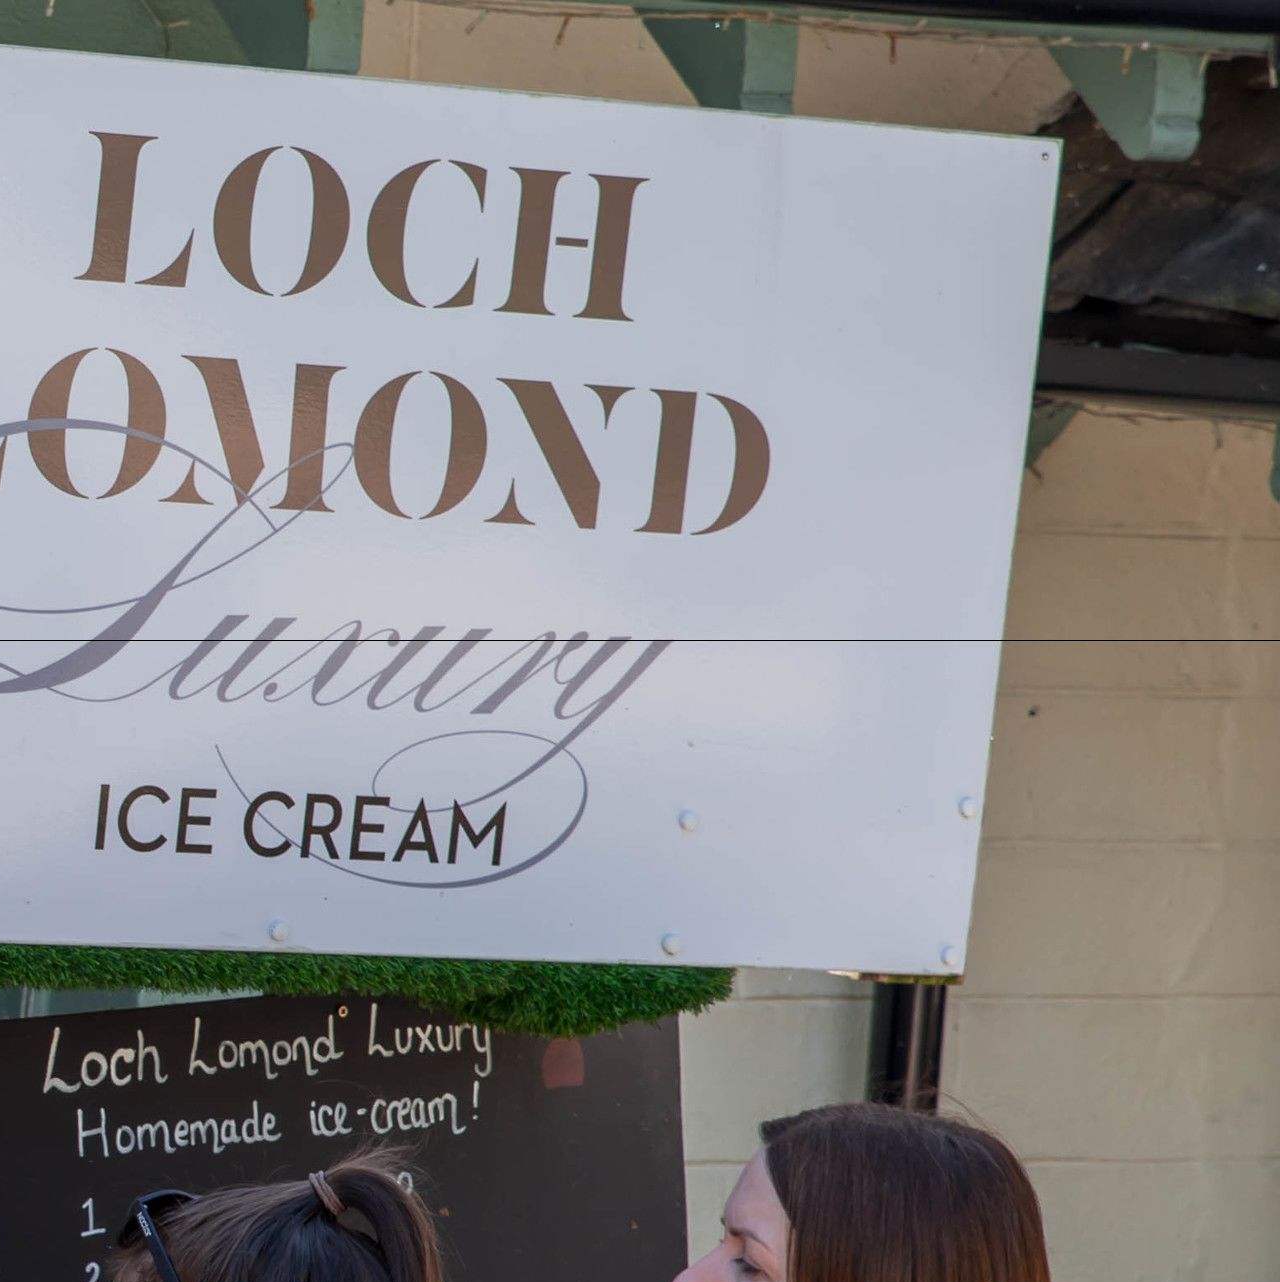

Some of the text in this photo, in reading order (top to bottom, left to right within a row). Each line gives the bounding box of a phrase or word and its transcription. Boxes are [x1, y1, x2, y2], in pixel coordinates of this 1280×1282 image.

[74, 130, 650, 321] LOCH
[95, 784, 507, 867] ICE CREAM
[43, 1003, 492, 1093] Loch Lomond Luxury
[77, 1100, 281, 1157] Homemade
[80, 1197, 107, 1237] 1
